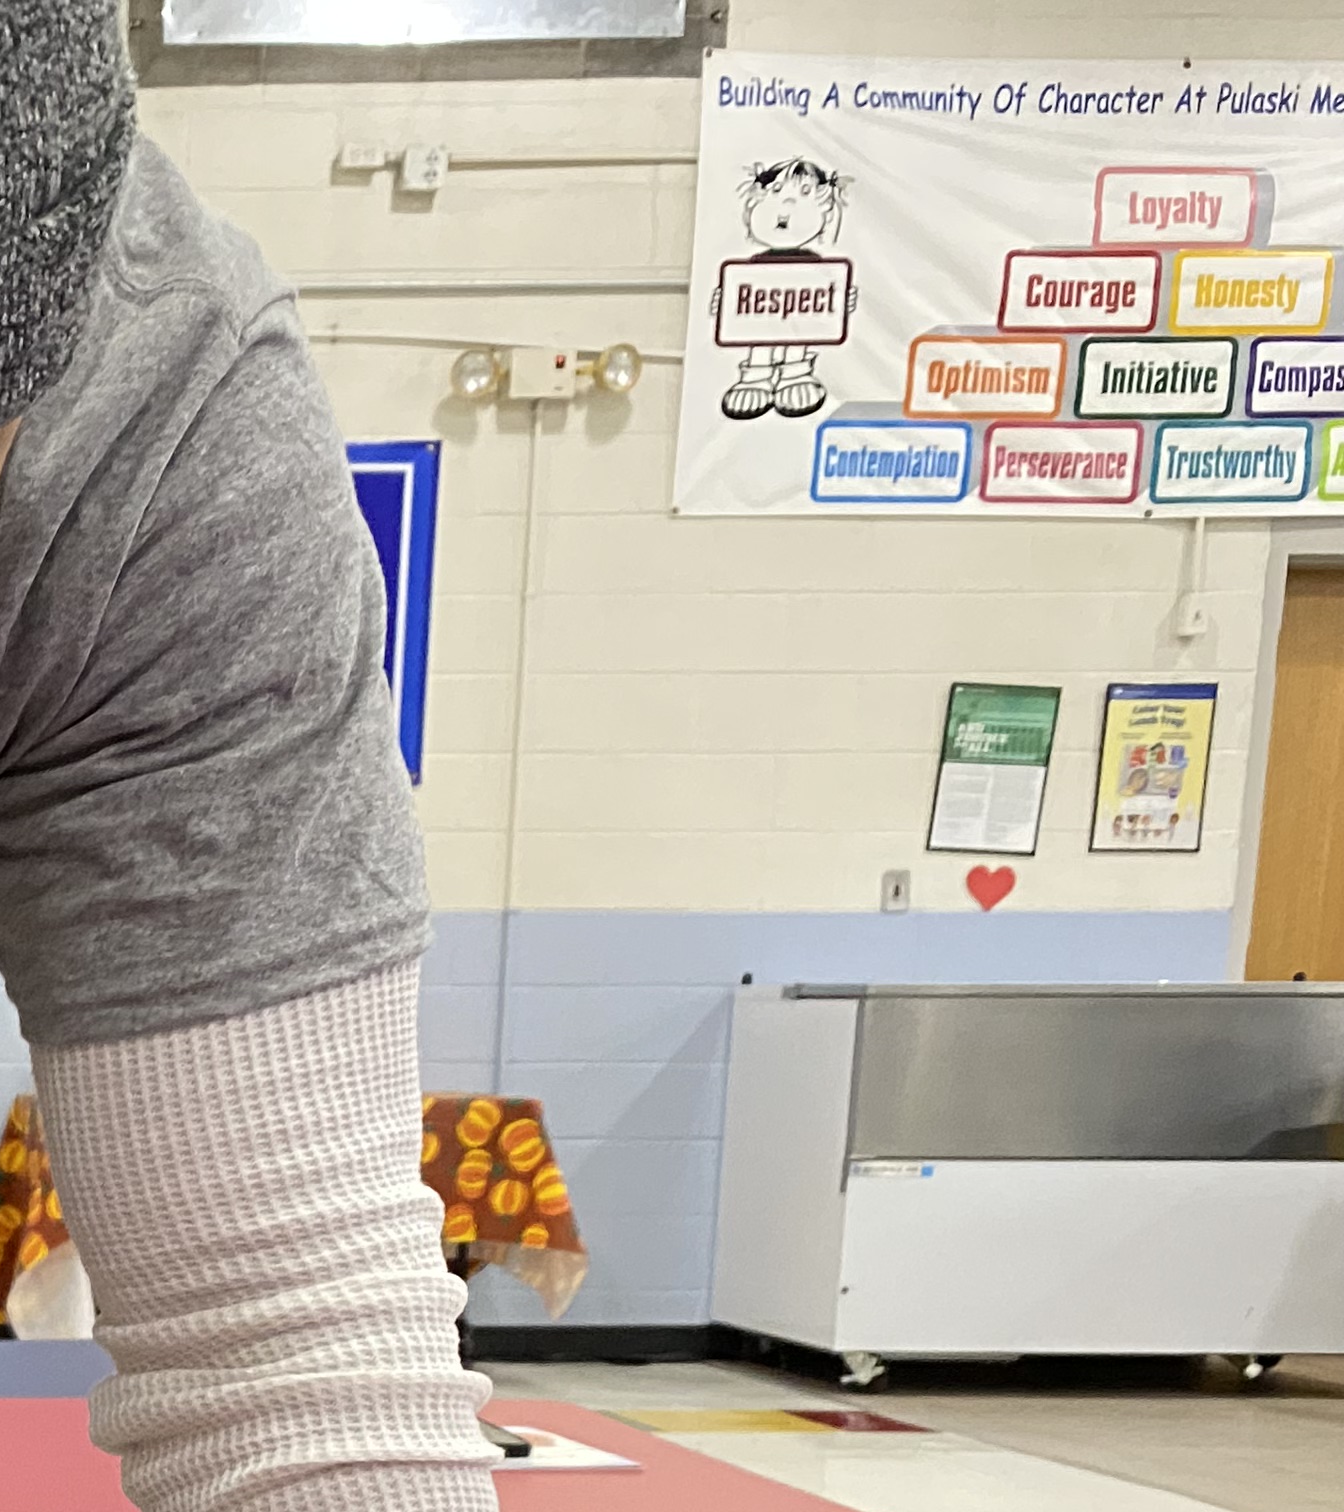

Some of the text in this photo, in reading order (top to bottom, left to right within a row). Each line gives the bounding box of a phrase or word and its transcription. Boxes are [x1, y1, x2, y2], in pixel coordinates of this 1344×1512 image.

[719, 76, 810, 117] Building
[821, 82, 840, 109] A
[853, 82, 982, 121] Community
[993, 82, 1028, 116] Of
[1038, 82, 1163, 115] Character
[1174, 83, 1207, 115] At
[1217, 81, 1301, 115] Pulaski
[1128, 191, 1223, 231] Loyalty
[736, 281, 836, 320] Respect
[1025, 273, 1136, 314] Courage
[1193, 273, 1301, 314] Honesty
[926, 360, 1052, 400] Optimism
[1100, 360, 1219, 395] Initiative
[823, 444, 960, 484] Contemplation
[992, 445, 1128, 481] Perseverance
[1166, 444, 1297, 484] Trustworthy
